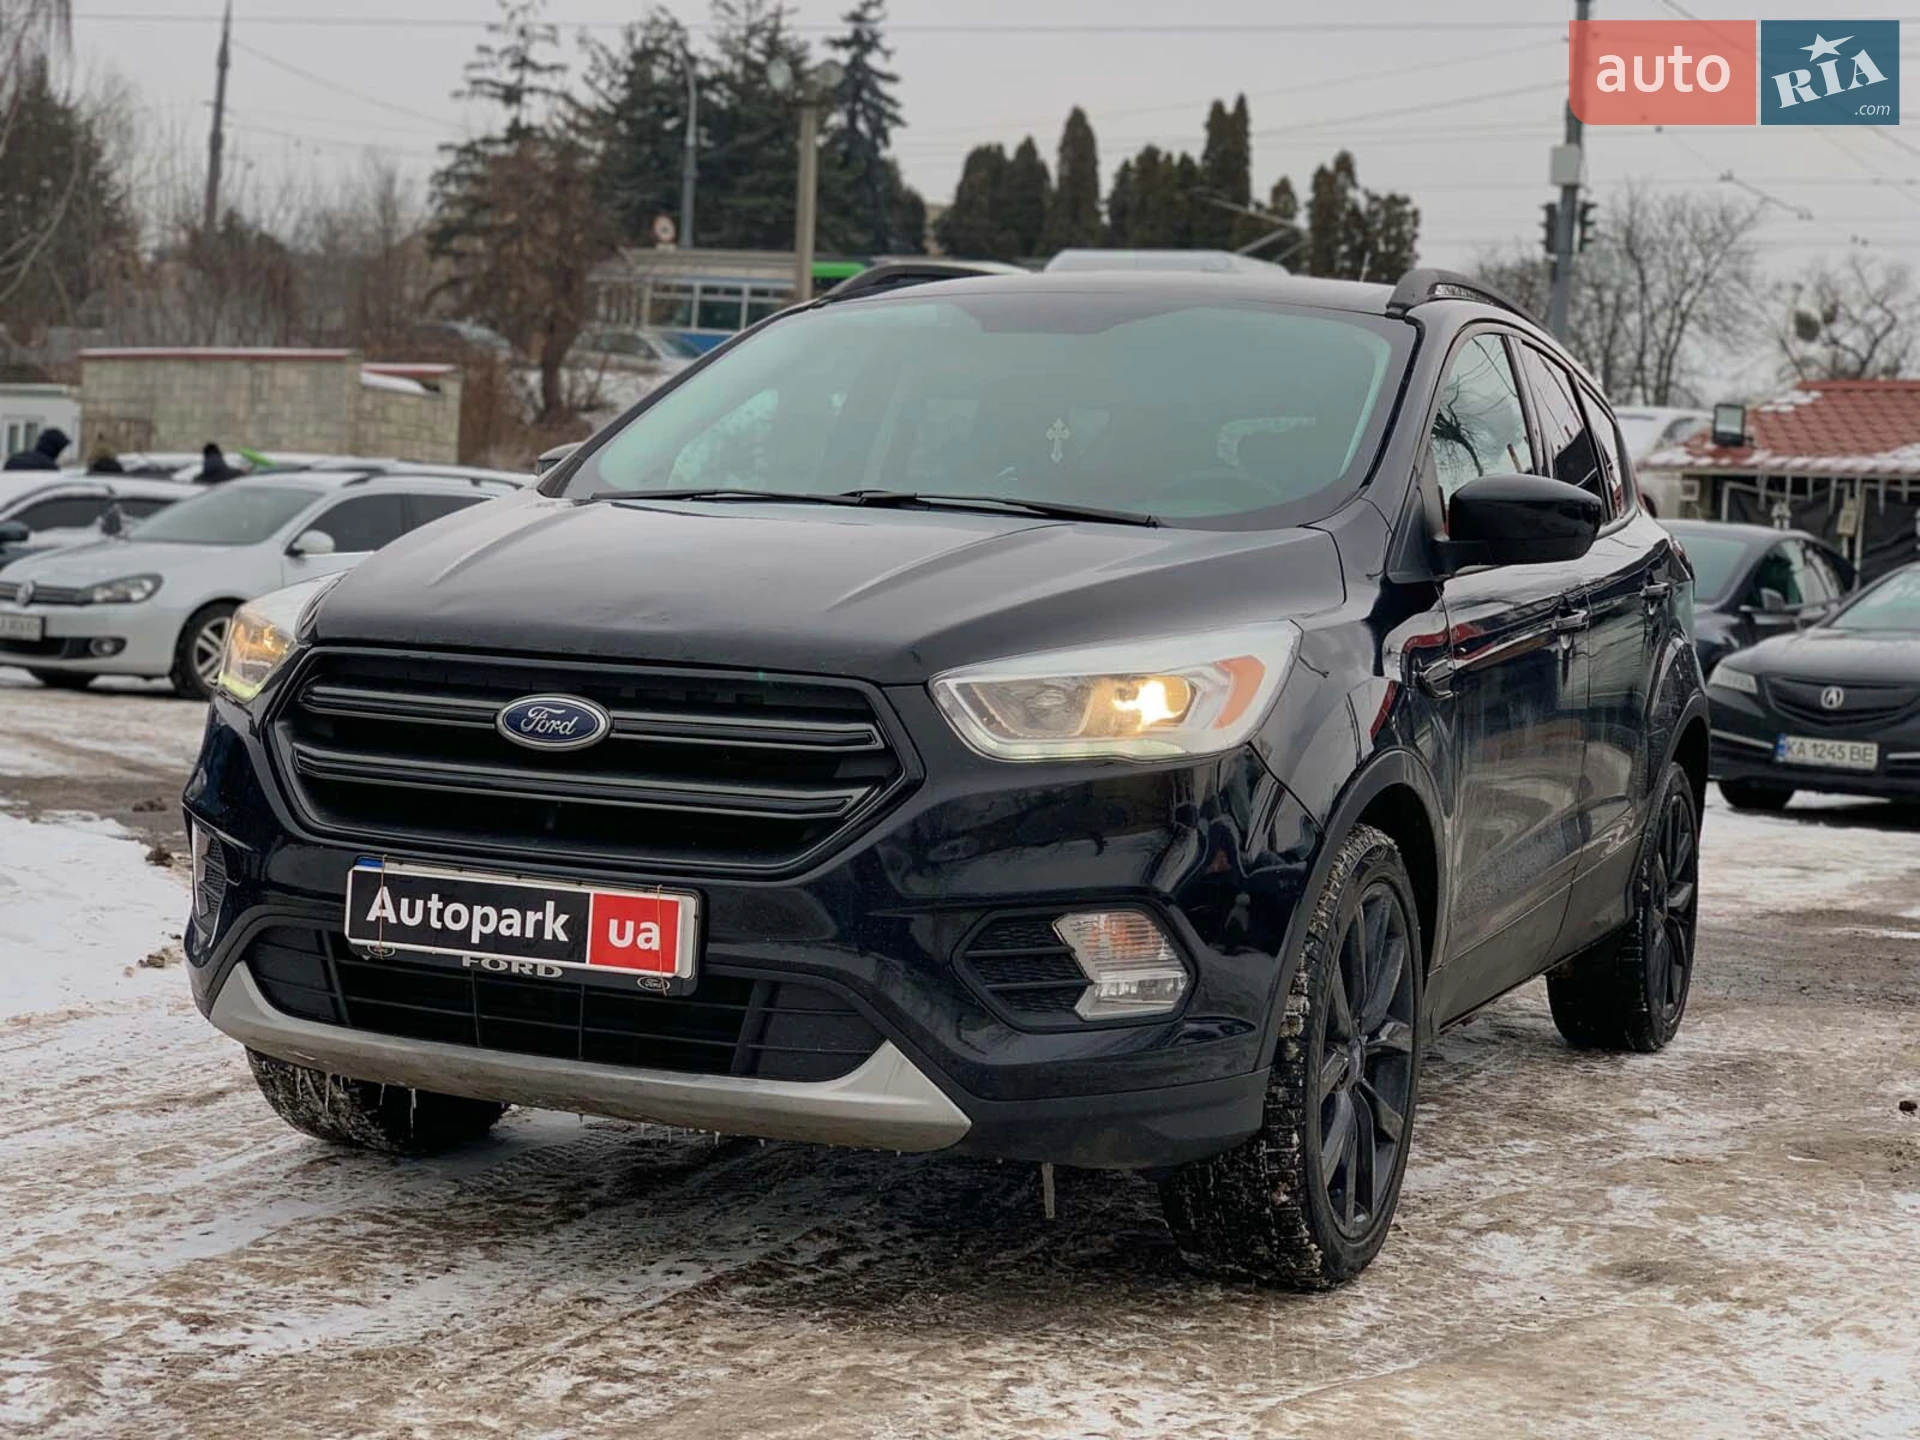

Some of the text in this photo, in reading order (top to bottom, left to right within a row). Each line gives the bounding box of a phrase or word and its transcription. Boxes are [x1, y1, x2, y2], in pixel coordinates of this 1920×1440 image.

[521, 706, 579, 736] Ford
[1811, 742, 1846, 760] 1245
[1849, 744, 1874, 763] BE
[366, 885, 661, 951] Autopark ua
[462, 954, 563, 978] FORD
